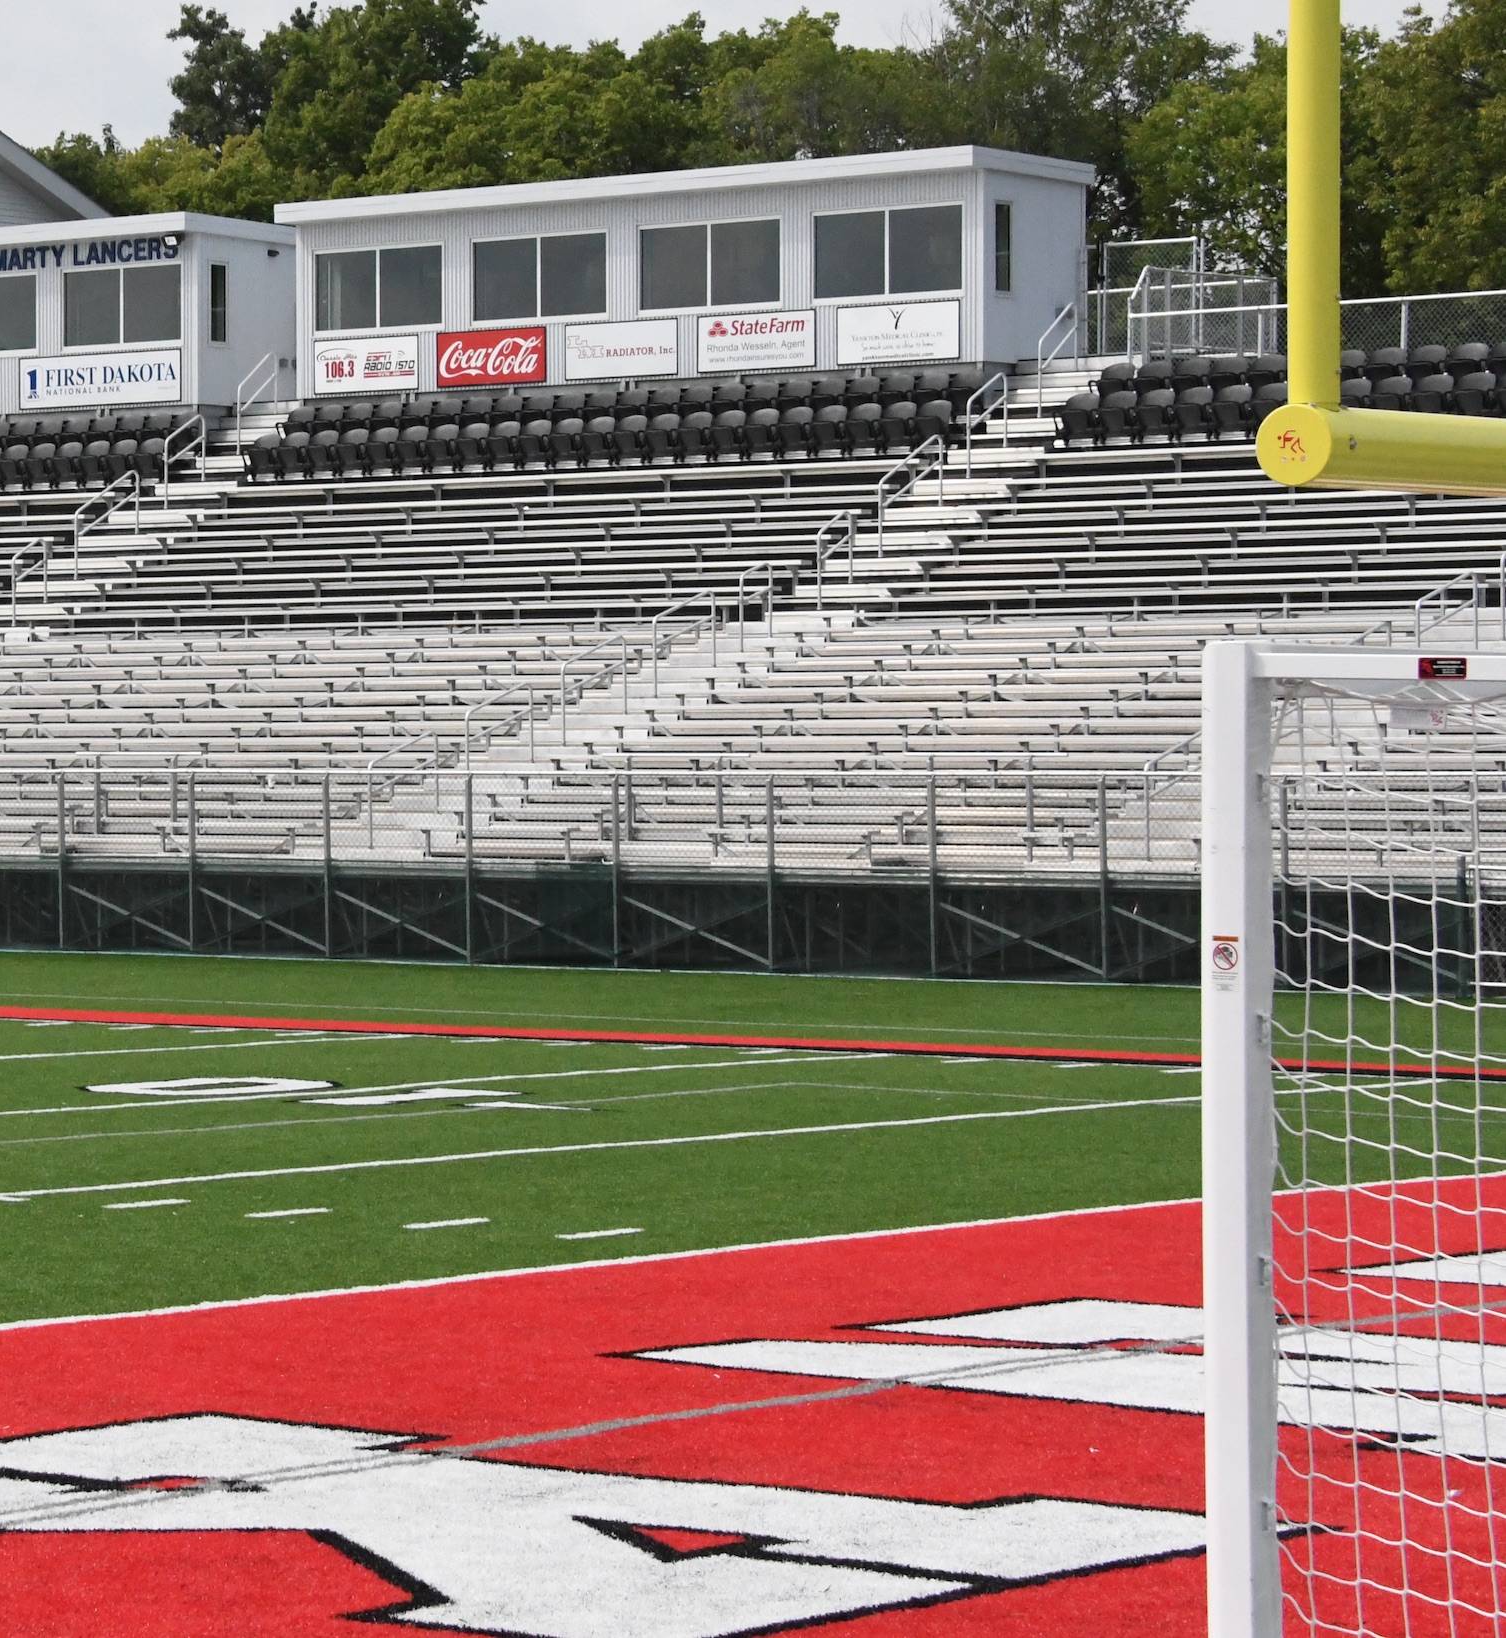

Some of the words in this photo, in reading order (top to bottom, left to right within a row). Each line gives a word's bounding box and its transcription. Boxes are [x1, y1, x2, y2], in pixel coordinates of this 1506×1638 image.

[73, 237, 179, 267] LANCERS
[707, 343, 739, 353] Rhonda
[781, 339, 805, 350] Agent
[325, 360, 355, 379] 106.3
[363, 361, 392, 371] RADIO
[395, 360, 415, 370] 1570
[46, 366, 98, 387] FIRST
[103, 362, 176, 384] DAKOTA
[46, 386, 92, 396] NATIONAL
